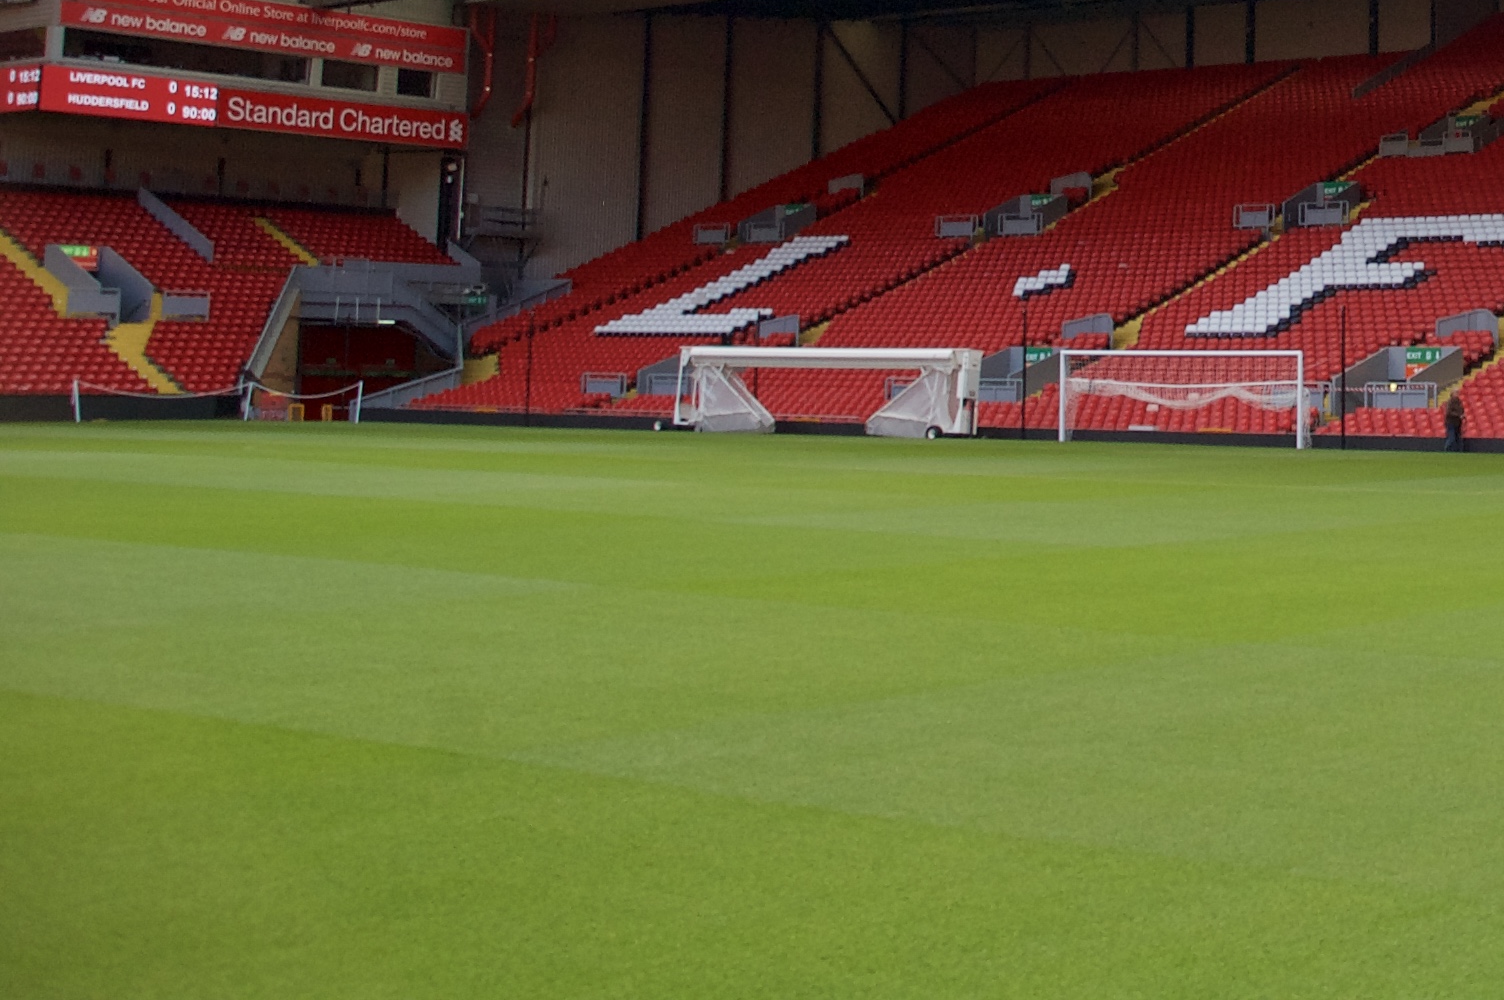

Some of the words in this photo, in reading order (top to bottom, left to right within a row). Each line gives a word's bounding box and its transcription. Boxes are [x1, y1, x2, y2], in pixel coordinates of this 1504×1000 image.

[111, 14, 143, 29] new
[146, 16, 207, 37] balance
[220, 0, 260, 17] Online
[263, 6, 294, 21] Store
[297, 12, 308, 23] at
[311, 13, 428, 40] liverpoolfc.com/store
[250, 32, 278, 45] new
[280, 33, 335, 53] balance
[375, 47, 401, 60] new
[403, 49, 453, 68] balance
[69, 71, 129, 88] LIVERPOOL
[131, 78, 146, 89] FC
[169, 81, 178, 94] 0
[184, 85, 218, 100] 15:12
[68, 93, 150, 112] HUDDERSFIELD
[167, 103, 176, 115] 0
[182, 106, 217, 121] 90:00
[228, 96, 334, 130] Standard
[340, 109, 446, 140] Chartered
